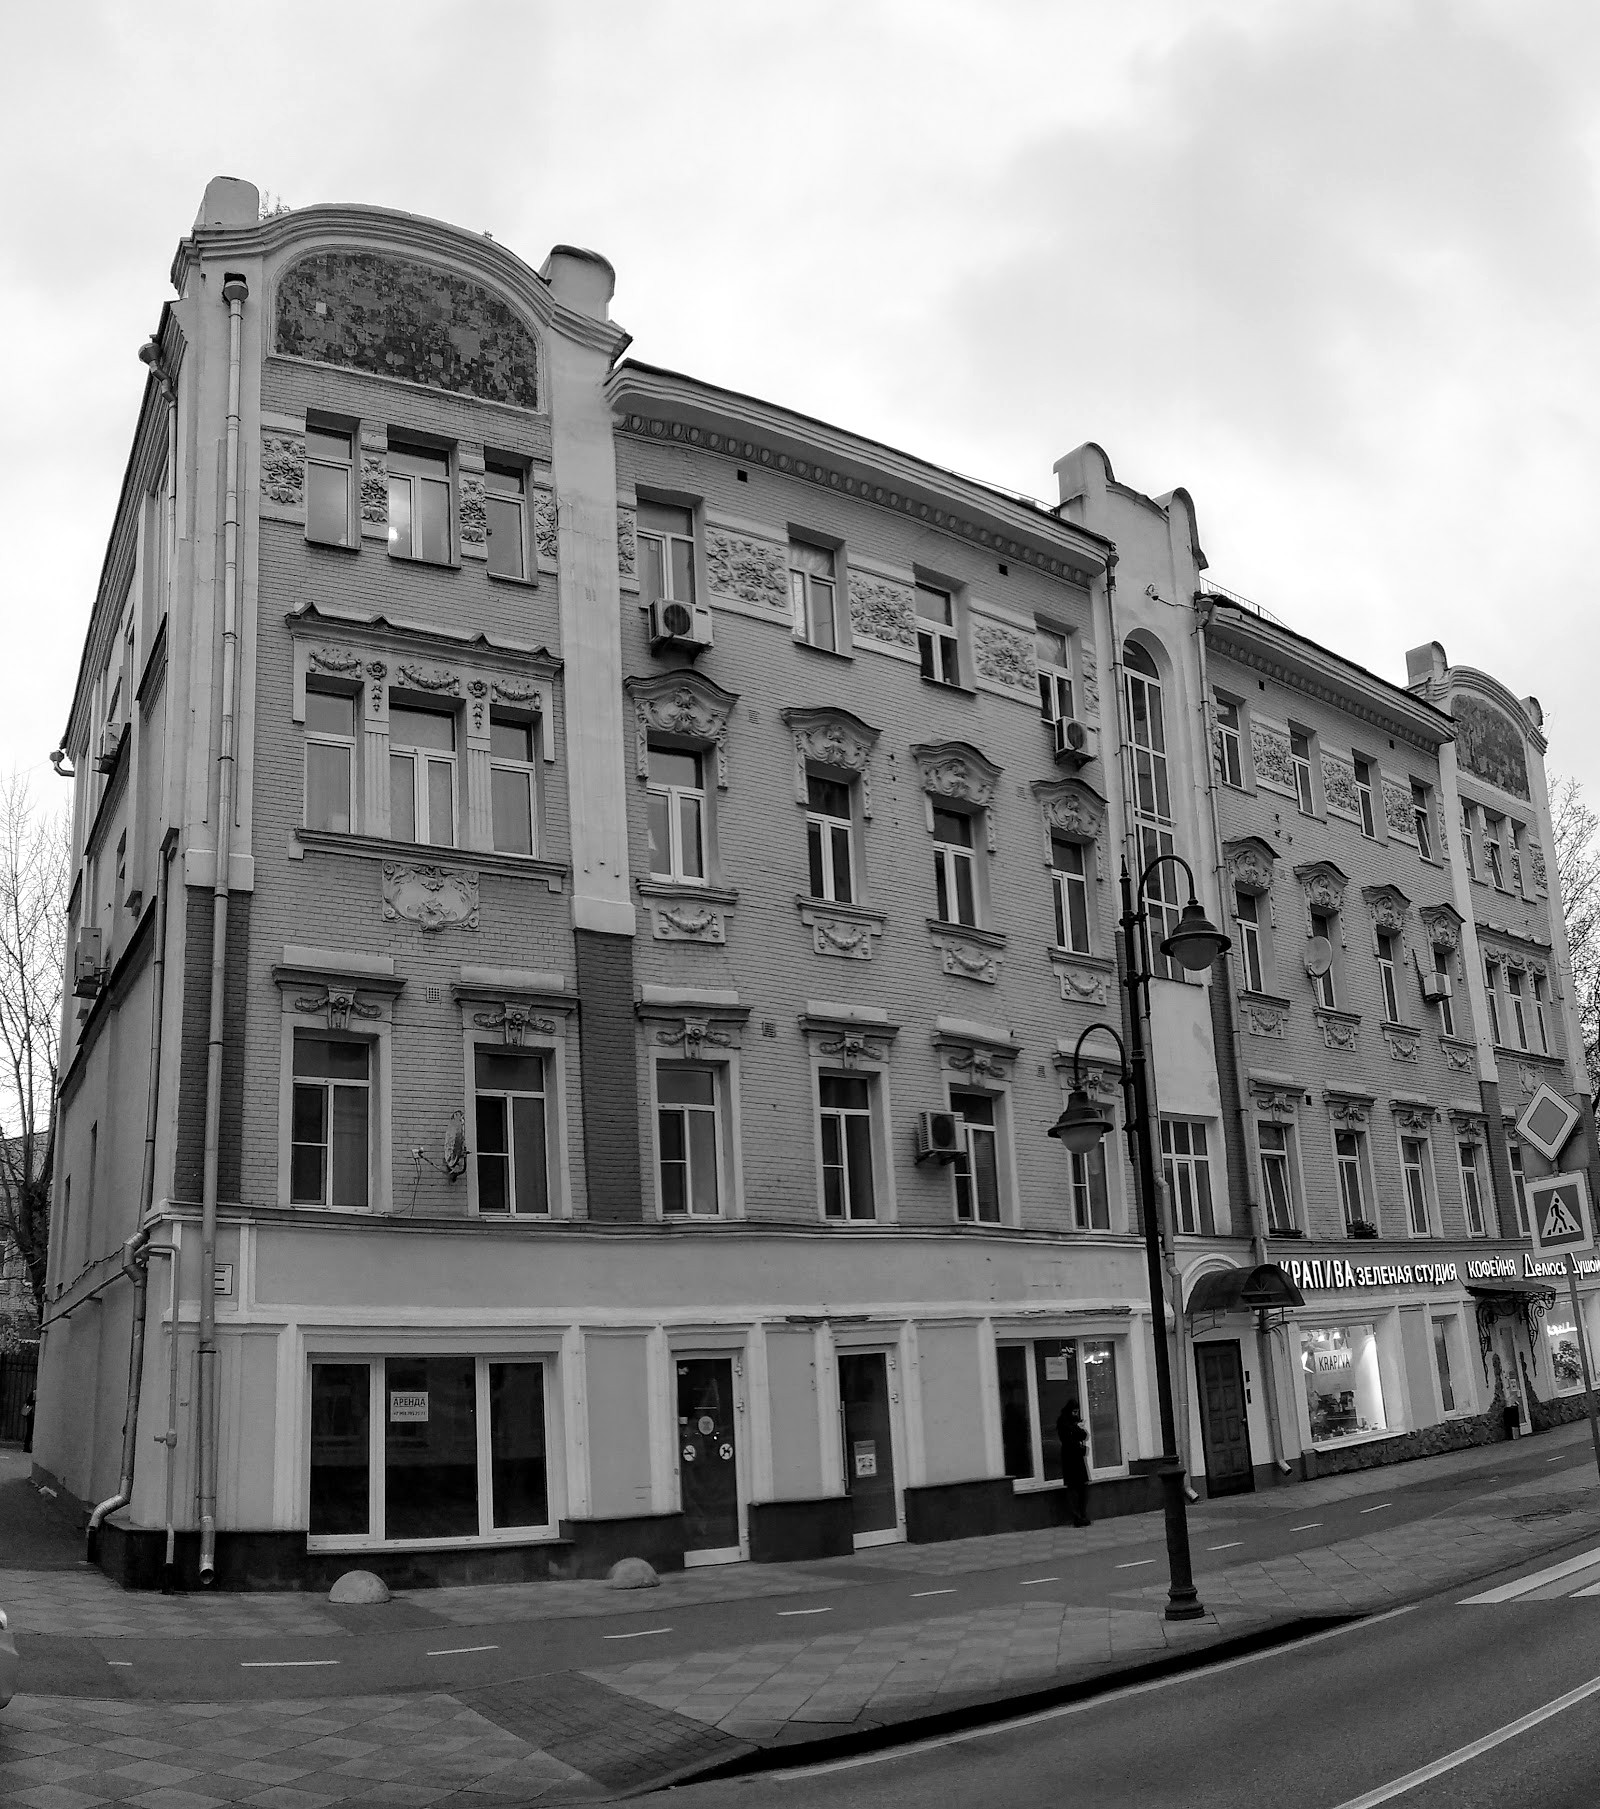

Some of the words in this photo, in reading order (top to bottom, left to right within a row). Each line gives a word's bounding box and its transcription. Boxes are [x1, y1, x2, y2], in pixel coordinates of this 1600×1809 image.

[1356, 1265, 1413, 1286] ЗЕЛЕНАЯ
[1414, 1263, 1458, 1285] СТУДИЯ
[1467, 1256, 1517, 1278] КОФЕЙНЯ
[1524, 1253, 1567, 1277] Делюсь
[393, 1398, 425, 1407] АРЕНДА
